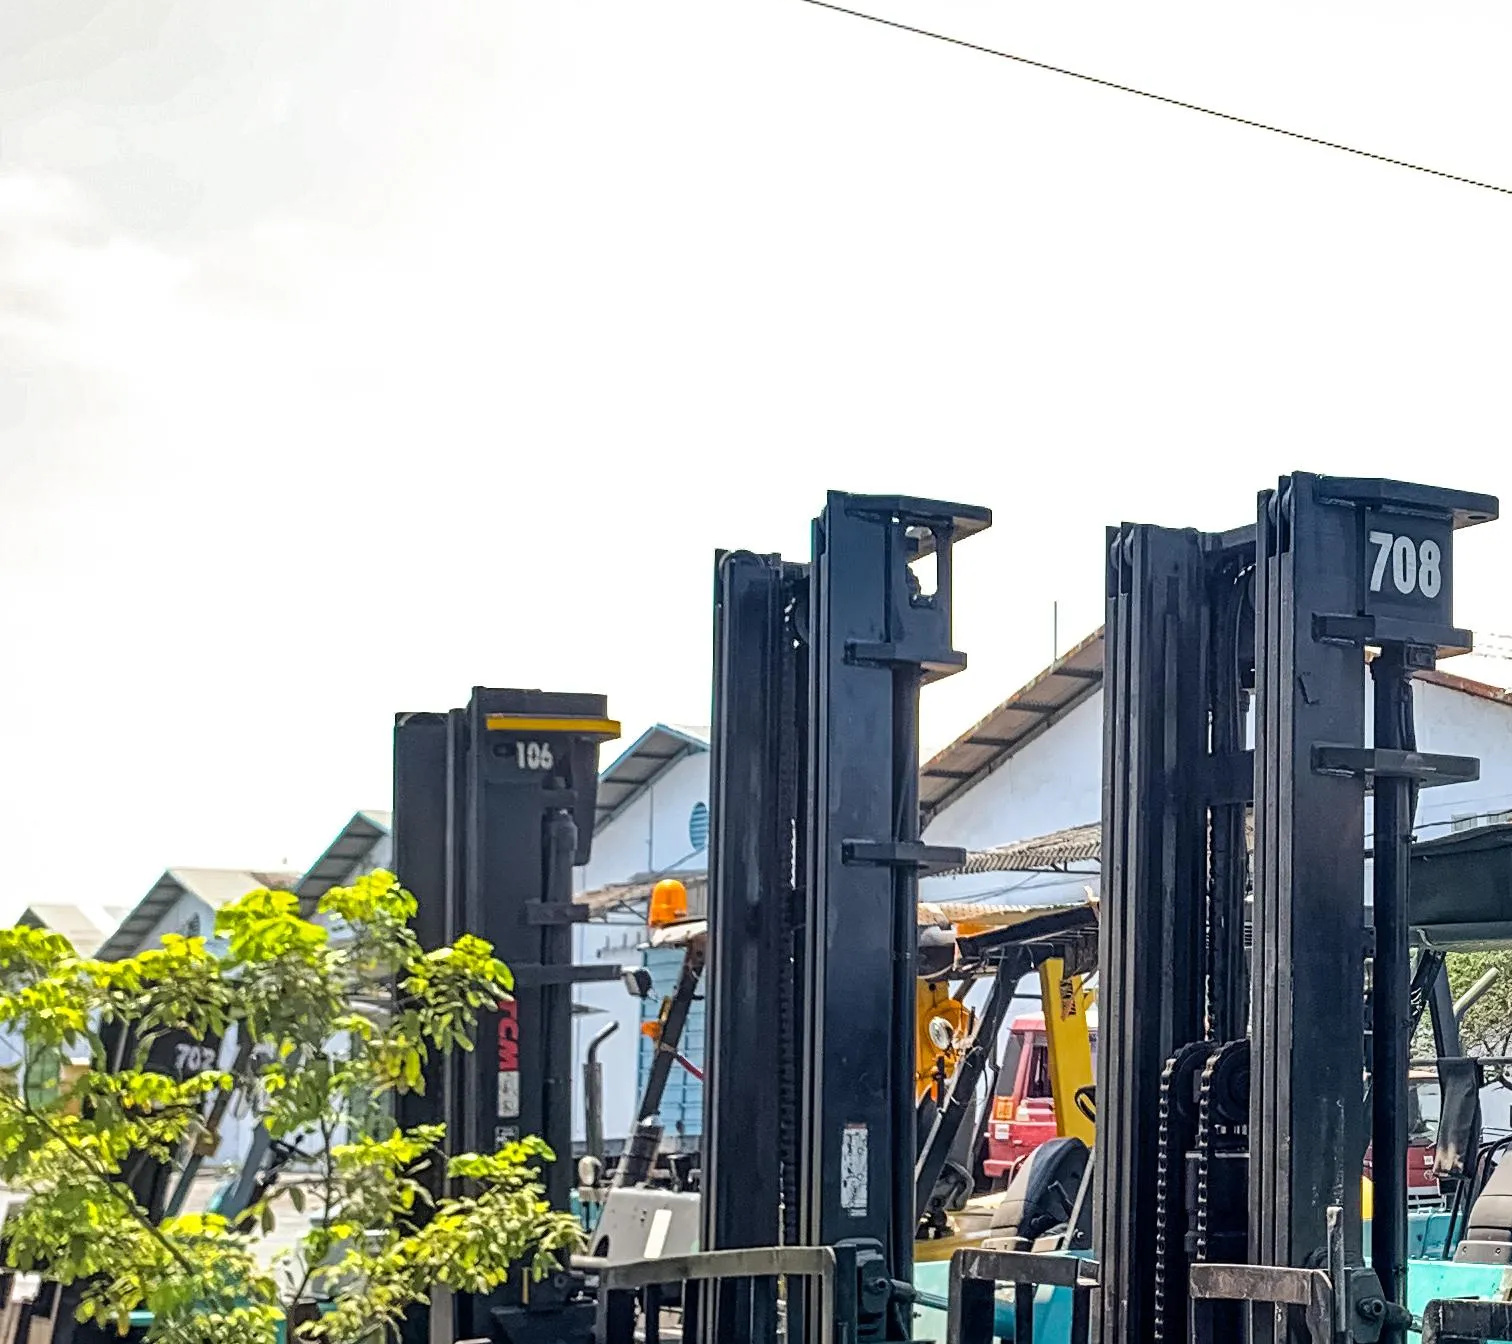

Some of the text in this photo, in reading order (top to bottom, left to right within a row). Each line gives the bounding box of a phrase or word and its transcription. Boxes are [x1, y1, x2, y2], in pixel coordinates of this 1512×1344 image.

[1369, 530, 1441, 598] 708
[516, 741, 553, 770] 106
[498, 999, 519, 1071] TCM
